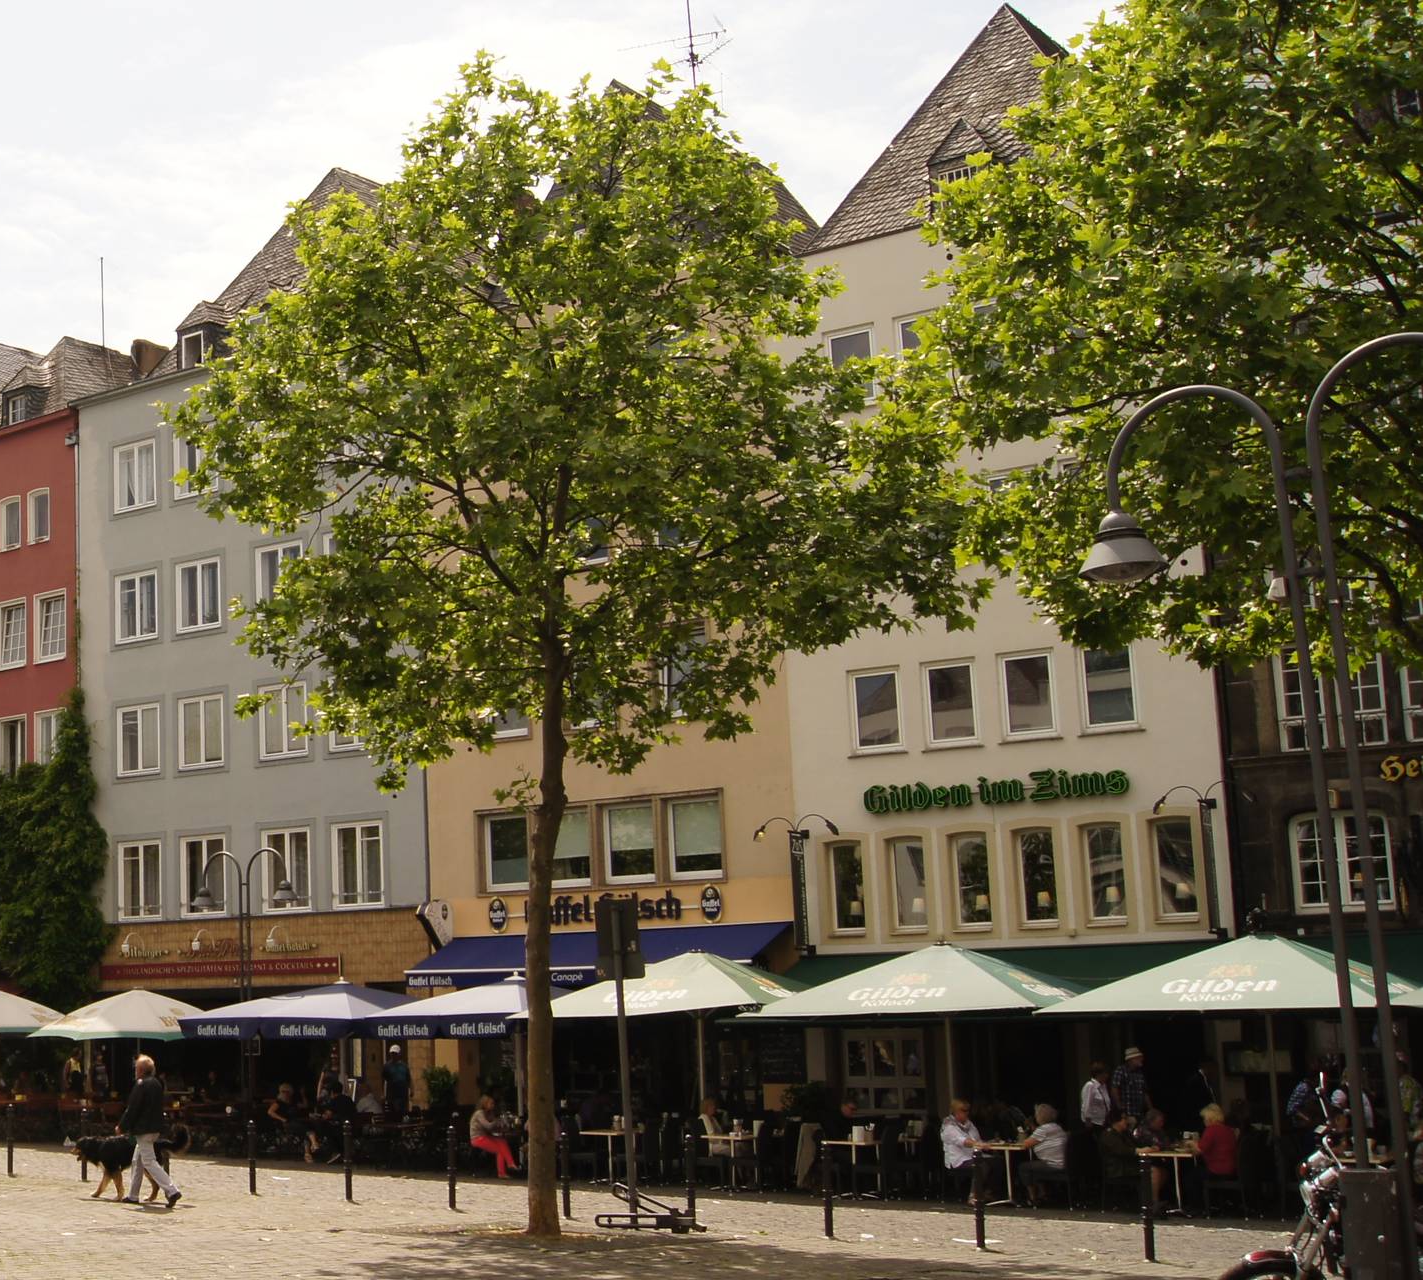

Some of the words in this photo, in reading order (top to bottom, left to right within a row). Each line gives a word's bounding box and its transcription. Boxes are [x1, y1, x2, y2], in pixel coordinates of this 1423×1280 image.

[863, 781, 973, 813] Gilden
[977, 776, 1025, 805] im
[1027, 768, 1130, 801] Zims
[275, 961, 314, 971] COCKTAILS
[408, 976, 429, 986] Gaffel
[430, 975, 452, 986] Kölsch
[1161, 977, 1279, 995] Gilden
[847, 984, 948, 1002] Gilden
[197, 1024, 217, 1036] Gaffel
[217, 1024, 240, 1036] Kölsch
[280, 1024, 302, 1037] Gaffel
[302, 1023, 327, 1036] Kölsch
[377, 1023, 401, 1037] Gaffel
[403, 1023, 429, 1036] Kölsch
[449, 1021, 476, 1036] Gaffel
[477, 1020, 506, 1035] Kölsch
